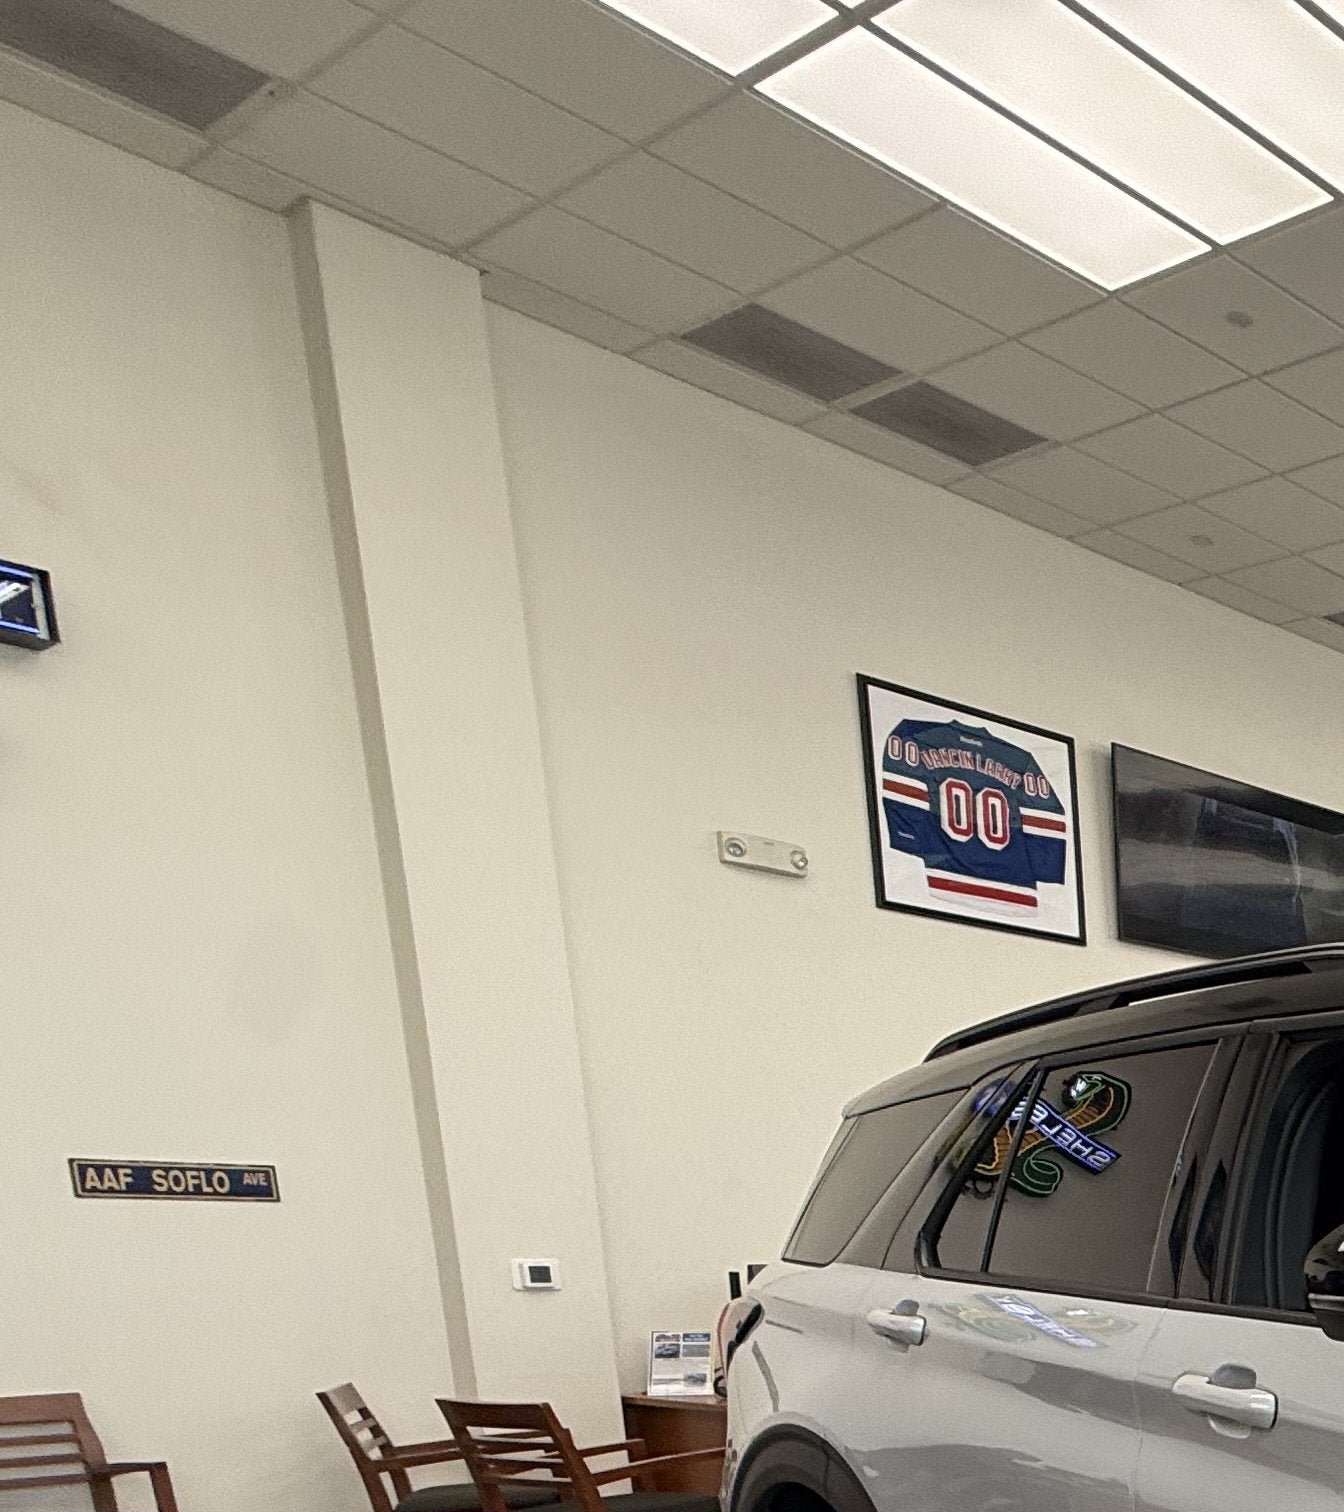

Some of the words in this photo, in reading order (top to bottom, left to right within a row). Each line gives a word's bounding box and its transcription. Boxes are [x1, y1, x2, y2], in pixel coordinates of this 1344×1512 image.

[888, 735, 920, 767] 00
[1023, 772, 1050, 799] 00
[939, 777, 1010, 851] 00
[84, 1167, 135, 1191] AAF
[151, 1169, 231, 1194] SOFLO
[242, 1172, 269, 1187] AVE
